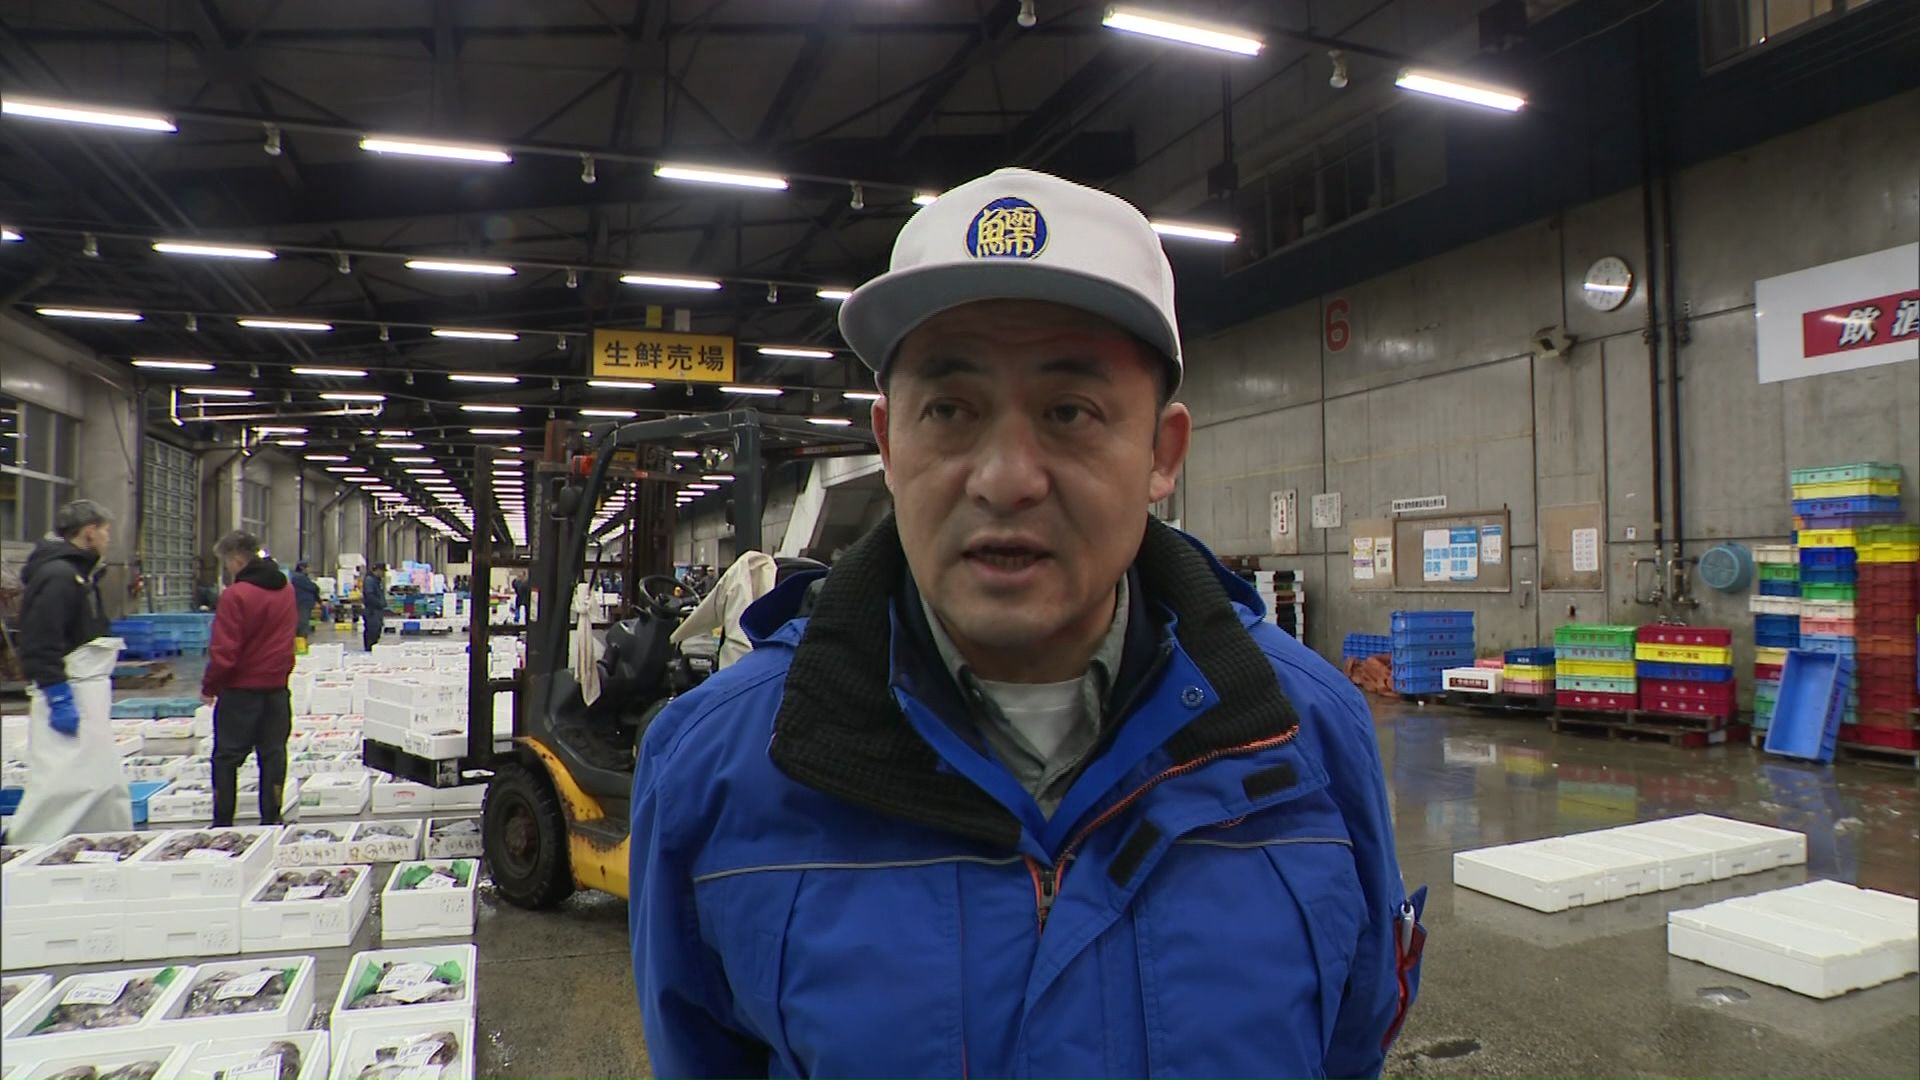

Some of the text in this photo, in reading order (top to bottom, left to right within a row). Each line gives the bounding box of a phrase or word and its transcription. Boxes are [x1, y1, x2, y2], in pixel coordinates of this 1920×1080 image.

[1324, 298, 1352, 353] 6
[602, 340, 725, 372] 生鮮売場
